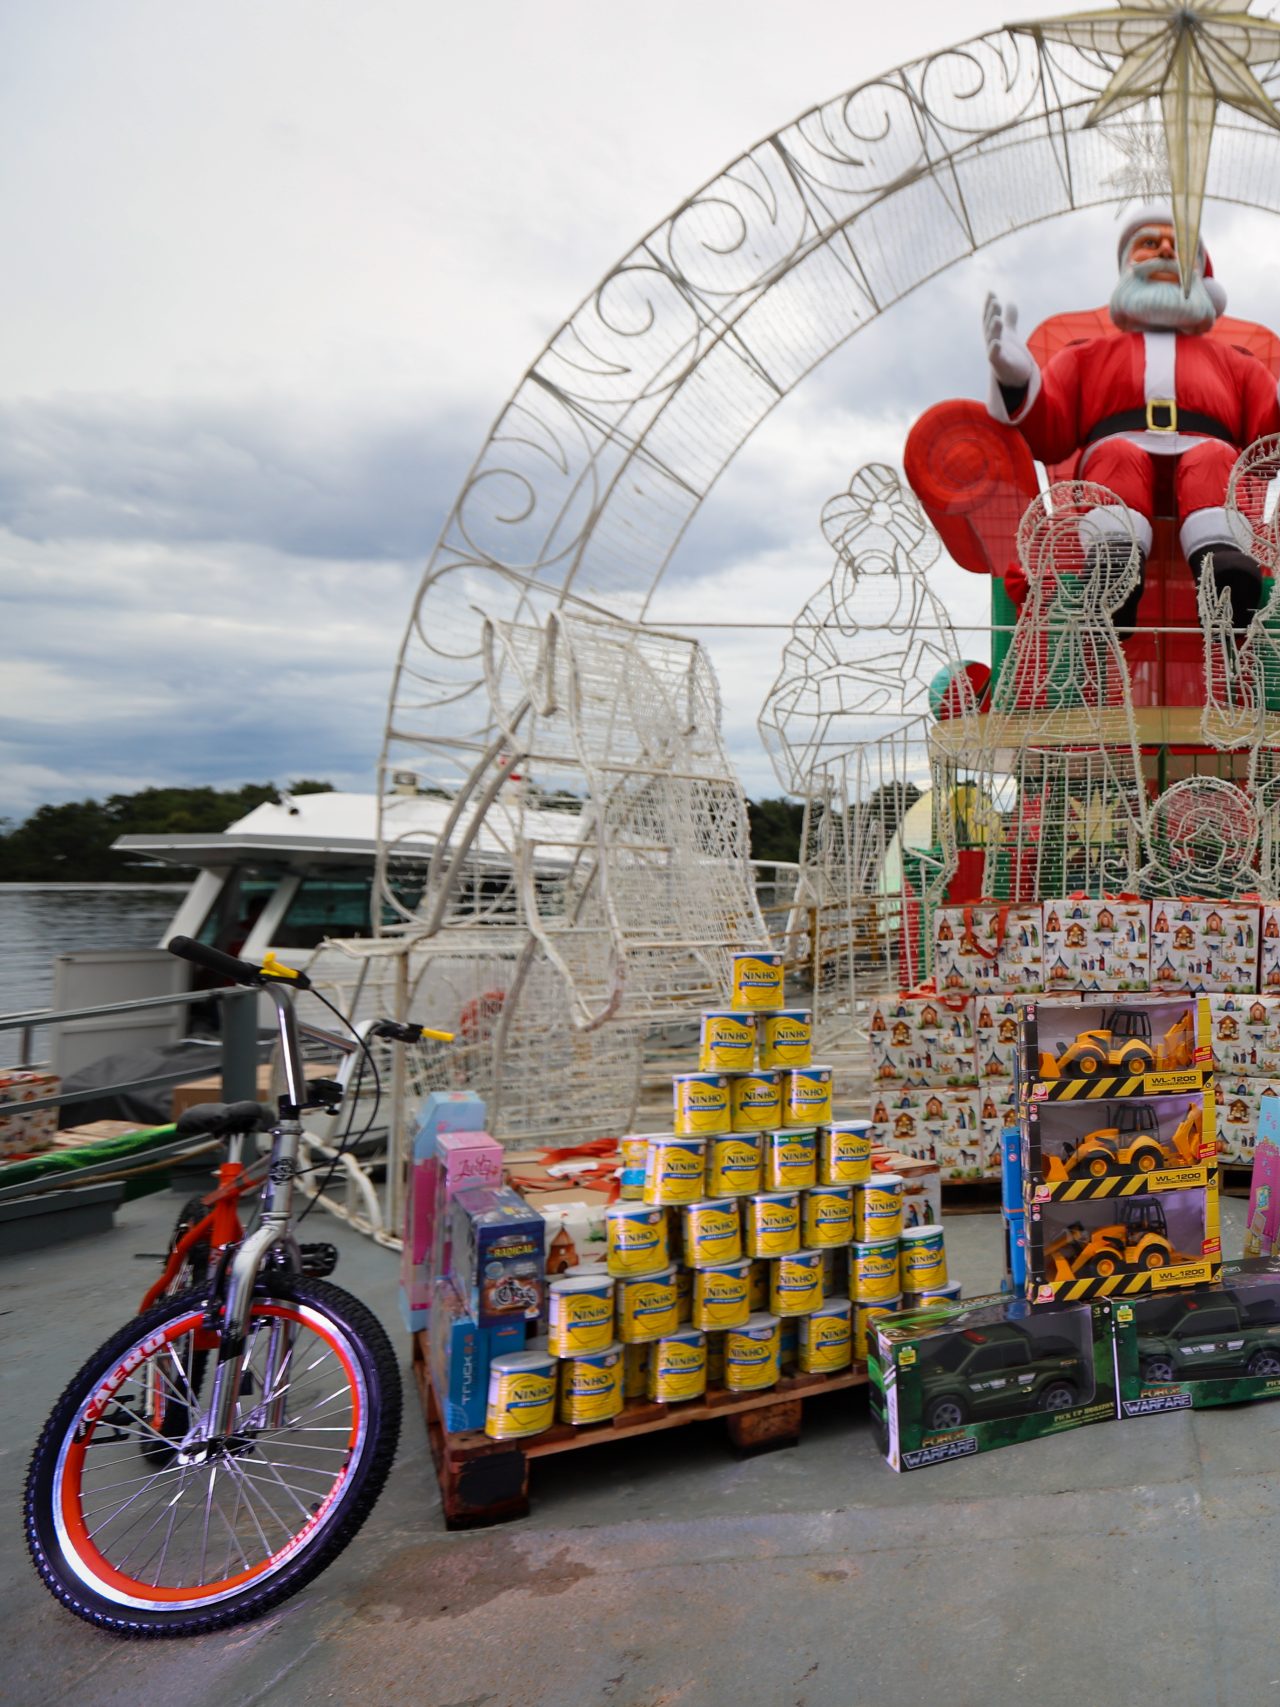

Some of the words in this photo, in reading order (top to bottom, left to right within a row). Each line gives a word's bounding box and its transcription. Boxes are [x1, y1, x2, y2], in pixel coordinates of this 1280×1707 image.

[742, 971, 776, 979] NINHO
[715, 1032, 748, 1040] NINHO
[776, 1030, 807, 1039] NINHO
[1151, 1075, 1197, 1084] WL-1200
[743, 1090, 776, 1100] NINHO
[791, 1088, 823, 1097] NINHO
[688, 1094, 722, 1104] NINHO
[838, 1146, 869, 1155] NINHO
[727, 1155, 757, 1164] NINHO
[781, 1152, 812, 1161] NINHO
[665, 1162, 698, 1171] NINHO
[1155, 1173, 1201, 1182] WL-1200
[819, 1206, 849, 1216] NINHO
[867, 1200, 897, 1211] NINHO
[761, 1215, 793, 1225] NINHO
[700, 1220, 734, 1233] NINHO
[616, 1232, 652, 1242] NINHO
[909, 1251, 939, 1263] NINHO
[863, 1261, 892, 1272] NINHO
[780, 1272, 814, 1284] NINHO
[1159, 1268, 1205, 1280] WL-1200
[708, 1286, 742, 1297] NINHO
[639, 1293, 672, 1307] NINHO
[573, 1307, 608, 1320] NINHO
[820, 1326, 849, 1339] NINHO
[731, 1346, 764, 1357] NINHO
[665, 1354, 699, 1366] NINHO
[570, 1374, 609, 1387] NINHO
[512, 1385, 551, 1400] NINHO
[1125, 1396, 1191, 1414] WARFARE
[906, 1439, 976, 1467] WARFARE
